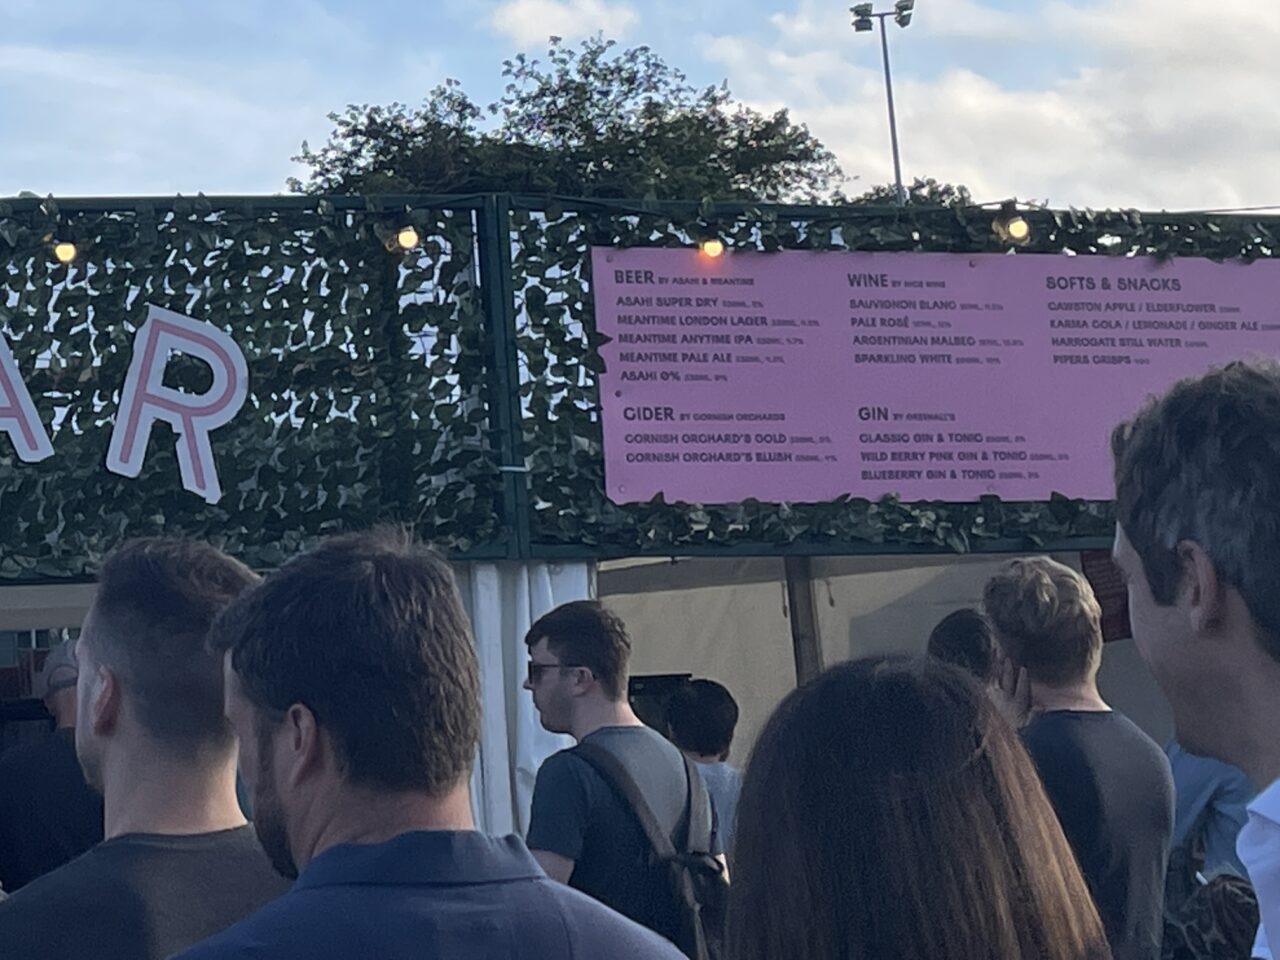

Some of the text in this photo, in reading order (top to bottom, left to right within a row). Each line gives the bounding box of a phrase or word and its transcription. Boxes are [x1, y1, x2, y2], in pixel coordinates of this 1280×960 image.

[614, 270, 655, 284] BEER
[847, 273, 888, 287] WINE
[1046, 276, 1181, 291] SOFTS & SNACKS
[616, 297, 653, 307] ASAHI
[656, 297, 693, 307] SUPER
[696, 297, 718, 307] DRY
[850, 299, 916, 309] SAUVIGNON
[919, 300, 957, 310] BLANC
[1048, 302, 1101, 312] CAWSTON
[1105, 302, 1135, 312] APPLE
[1146, 303, 1216, 313] ELDERFLOWER
[617, 315, 676, 325] MEANTIME
[679, 316, 727, 326] LONDON
[731, 316, 768, 326] LAGER
[851, 317, 876, 327] PALE
[880, 316, 909, 328] ROSÉ
[1050, 320, 1088, 328] KARMA
[1092, 320, 1122, 329] COLA
[1132, 320, 1187, 330] LEMONADE
[1198, 321, 1237, 330] GINGER
[1241, 321, 1258, 331] ALE
[619, 334, 677, 344] MEANTIME
[681, 334, 731, 344] ANYTIME
[734, 335, 753, 344] IPA
[853, 336, 928, 345] ARGENTINIAN
[931, 336, 976, 346] MALBEC
[1052, 337, 1116, 347] HARROGATE
[1119, 338, 1144, 347] STILL
[1147, 338, 1181, 347] WATER
[620, 352, 678, 362] MEANTIME
[682, 353, 708, 363] PALE
[712, 353, 732, 363] ALE
[855, 354, 916, 364] SPARKLING
[919, 354, 952, 364] WHITE
[1053, 355, 1089, 364] PIPERS
[1092, 355, 1131, 365] CRISPS
[621, 371, 657, 381] ASAHI
[660, 371, 680, 381] 0%
[624, 407, 675, 421] CIDER
[859, 407, 888, 421] GIN
[625, 434, 678, 444] CORNISH
[682, 434, 751, 444] ORCHARD'S
[755, 433, 787, 443] GOLD
[859, 433, 910, 443] CLASSIC
[913, 433, 933, 443] GIN
[937, 433, 944, 443] &
[948, 433, 983, 443] TONIC
[626, 453, 679, 463] CORNISH
[683, 452, 752, 462] ORCHARD'S
[756, 452, 792, 462] BLUSH
[860, 452, 888, 461] WILD
[891, 452, 925, 461] BERRY
[929, 452, 954, 461] PINK
[958, 452, 978, 461] GIN
[981, 451, 988, 461] &
[993, 451, 1027, 461] TONIC
[861, 470, 922, 480] BLUEBERRY
[926, 470, 946, 479] GIN
[950, 470, 957, 479] &
[961, 470, 996, 479] TONIC
